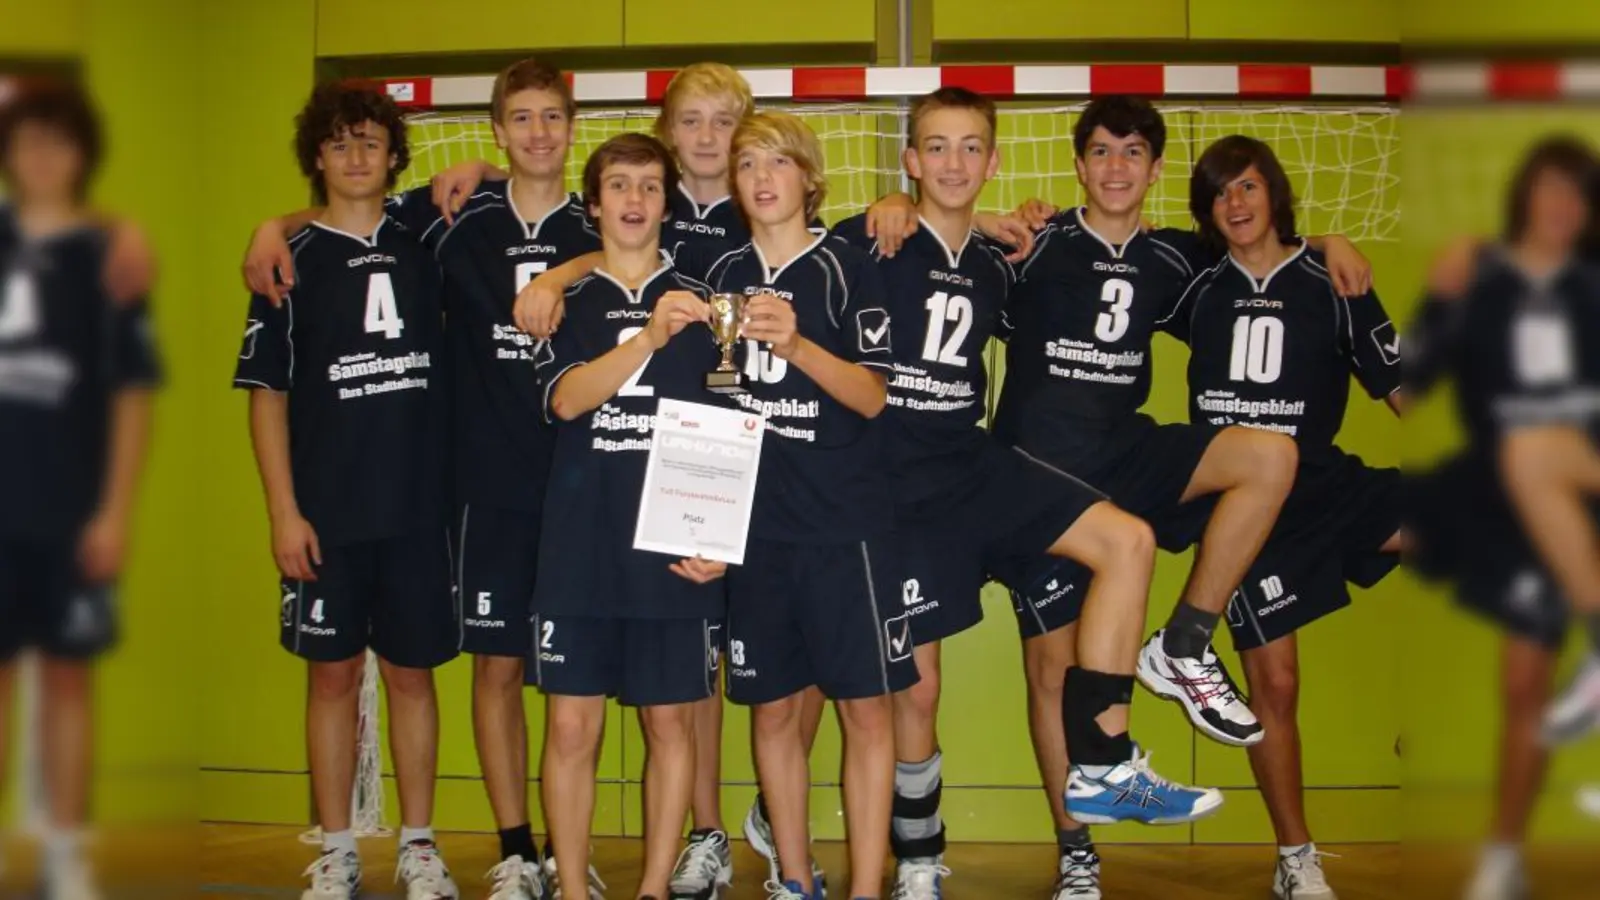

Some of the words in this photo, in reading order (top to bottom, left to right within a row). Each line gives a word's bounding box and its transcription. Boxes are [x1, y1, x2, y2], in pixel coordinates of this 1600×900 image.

[675, 221, 726, 237] GIVOVA
[347, 254, 398, 268] GIVOVA
[505, 245, 557, 256] GIVOVA
[1092, 262, 1139, 274] GIVOVA
[364, 272, 404, 339] 4
[606, 309, 653, 319] GIVOV
[1095, 278, 1134, 342] 3
[1234, 299, 1283, 309] GIVOVA
[921, 291, 973, 367] 12
[1229, 315, 1284, 383] 10
[1197, 394, 1305, 418] Samstagsblatt
[903, 578, 924, 606] 12
[1259, 575, 1284, 601] 10
[310, 598, 325, 623] 4
[477, 591, 492, 616] 5
[905, 600, 939, 617] IVOVA
[1257, 594, 1298, 617] GIVOVA
[540, 620, 555, 649] 2
[730, 638, 746, 666] 13
